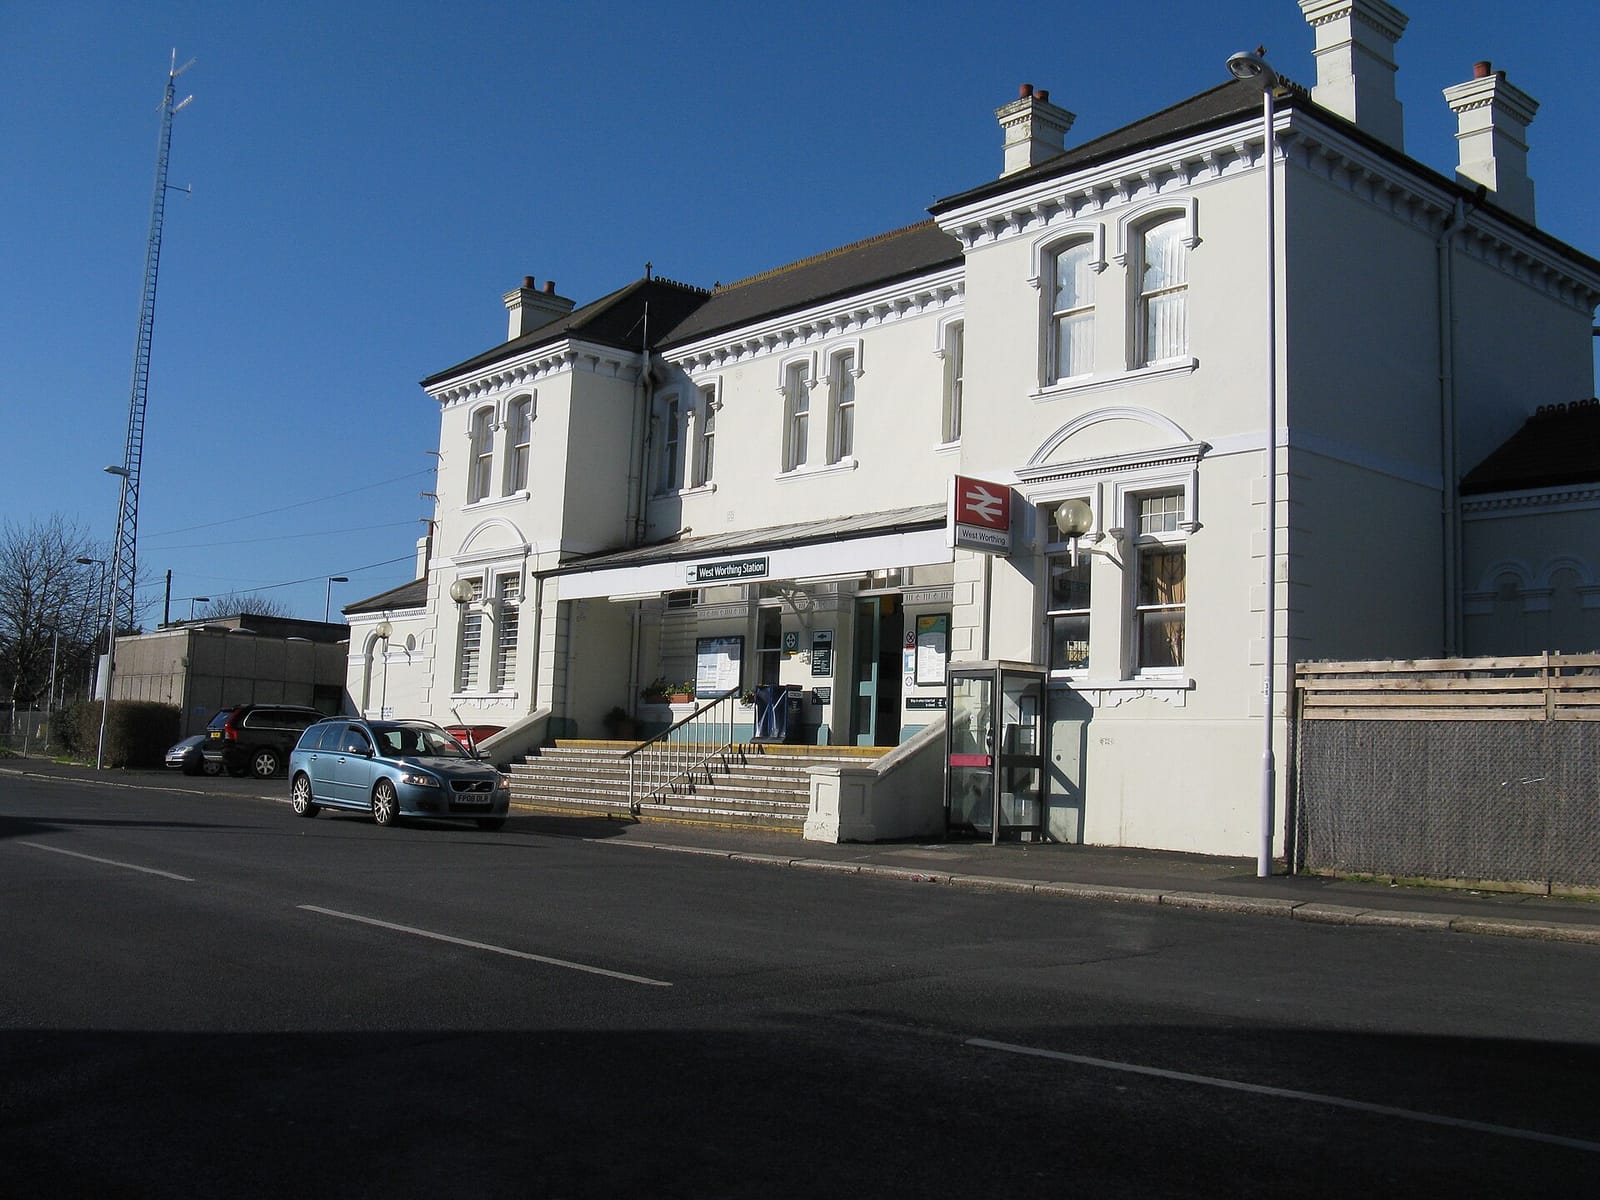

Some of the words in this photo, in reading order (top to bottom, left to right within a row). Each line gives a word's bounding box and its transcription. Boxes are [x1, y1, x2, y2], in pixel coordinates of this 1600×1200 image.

[962, 529, 978, 540] West
[979, 532, 1006, 545] Worthing
[699, 567, 714, 578] West
[714, 564, 742, 576] Worthing
[742, 561, 765, 573] Station
